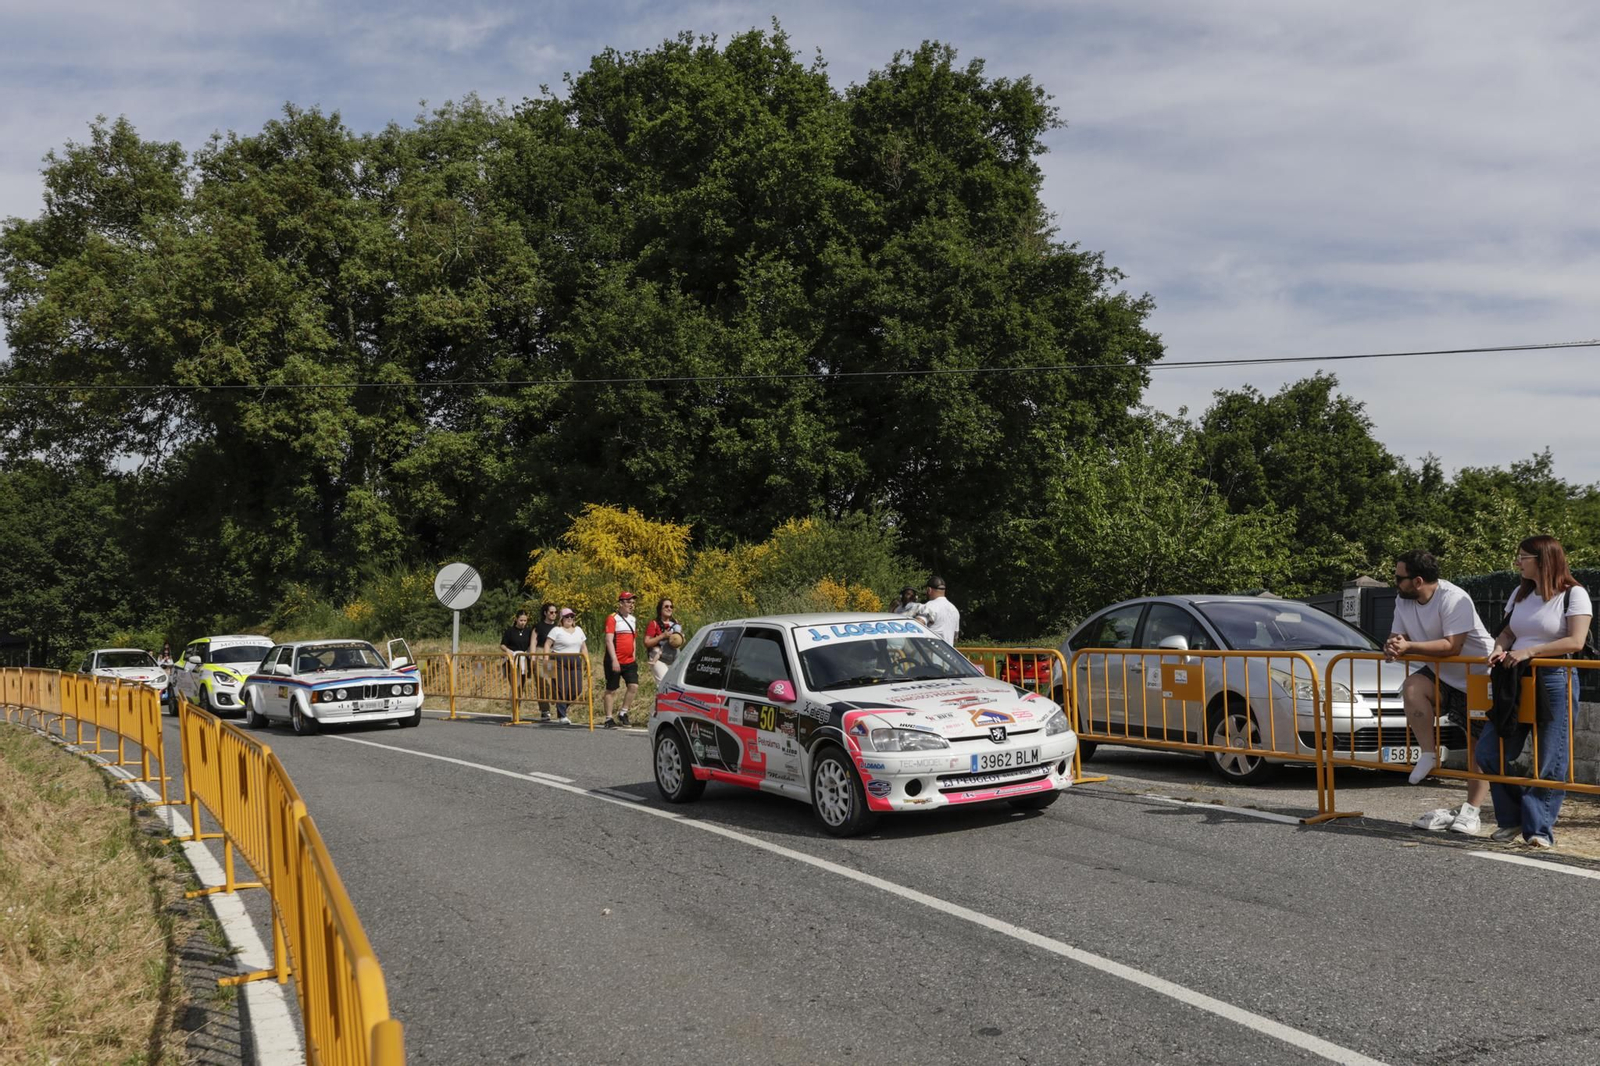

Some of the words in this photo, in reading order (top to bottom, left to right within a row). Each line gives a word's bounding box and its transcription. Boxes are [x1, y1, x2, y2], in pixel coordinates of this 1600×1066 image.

[1345, 600, 1354, 612] 38
[808, 627, 830, 642] J.
[830, 621, 924, 638] LOSADA
[760, 705, 775, 731] 50
[981, 752, 1012, 770] 3962
[1016, 749, 1039, 765] BLM
